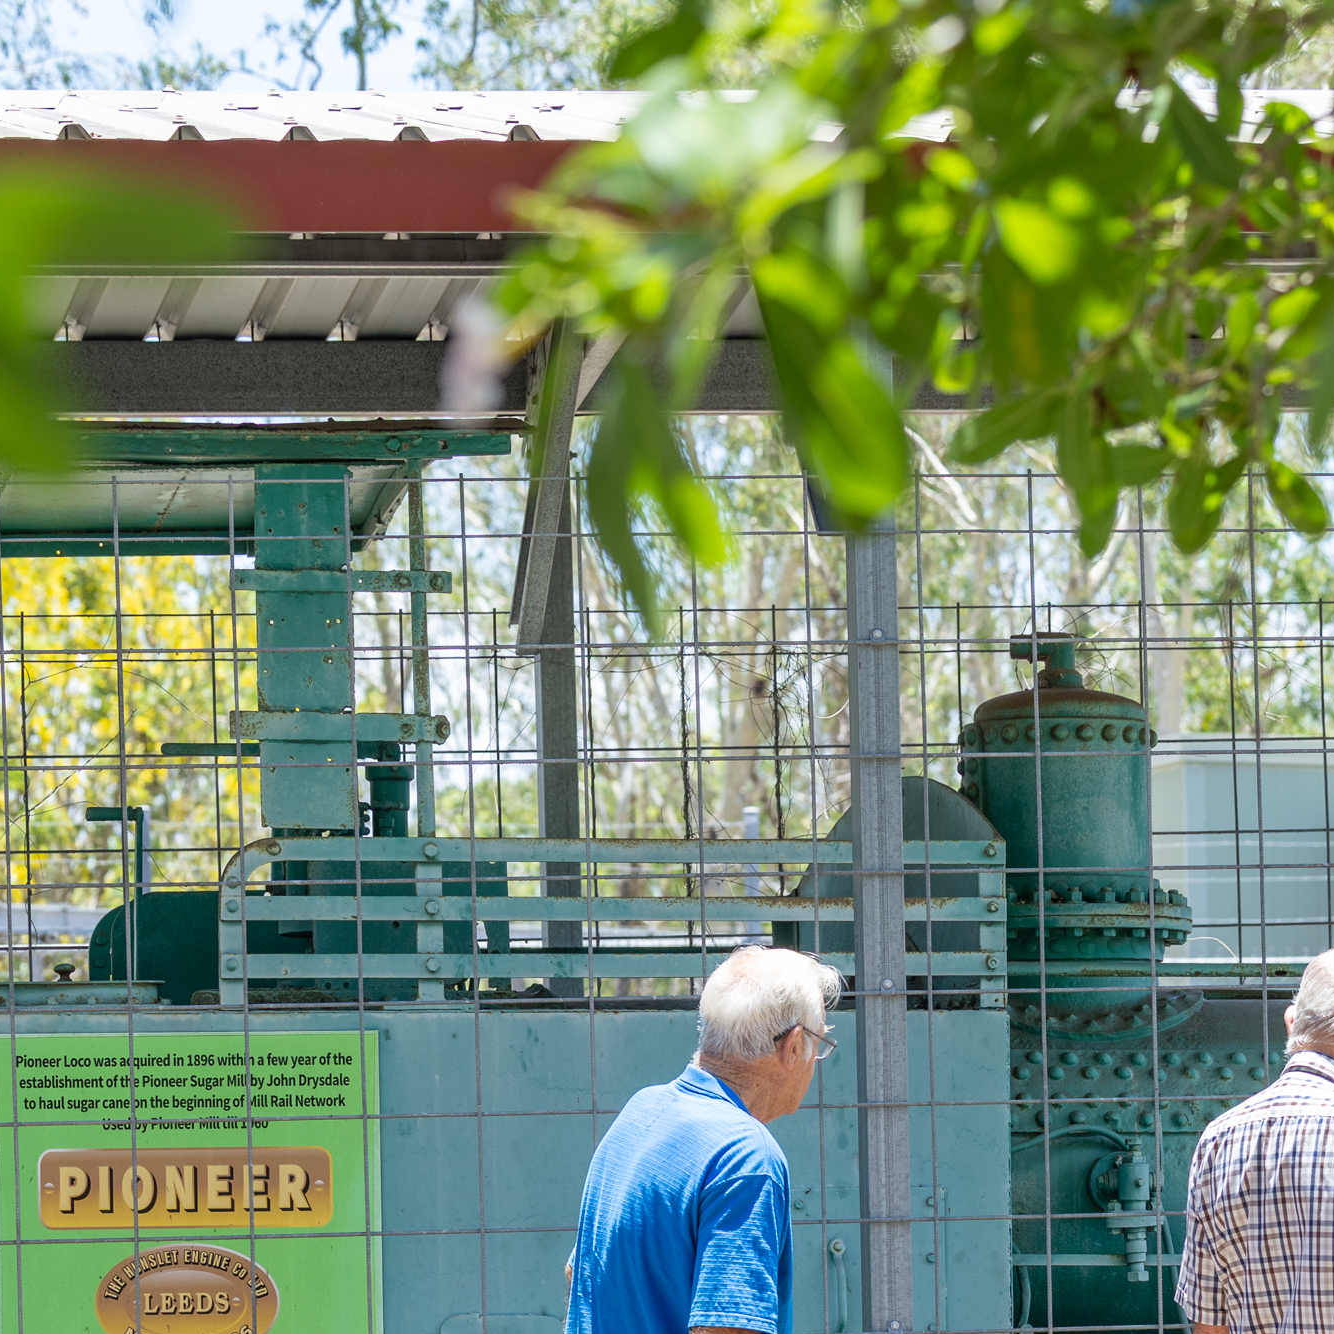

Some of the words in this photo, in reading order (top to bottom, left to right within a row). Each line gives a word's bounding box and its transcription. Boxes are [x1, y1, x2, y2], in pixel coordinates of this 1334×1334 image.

[16, 1054, 62, 1067] Pioneer
[64, 1055, 91, 1067] Loco
[93, 1057, 117, 1067] was
[119, 1054, 170, 1070] acquired
[173, 1054, 184, 1066] in
[187, 1054, 215, 1066] 1896
[217, 1053, 255, 1066] within
[257, 1056, 265, 1066] a
[266, 1053, 288, 1066] few
[291, 1055, 317, 1069] year
[319, 1053, 332, 1065] of
[333, 1053, 353, 1065] the
[19, 1075, 104, 1089] establishment
[106, 1075, 119, 1088] of
[120, 1074, 140, 1088] the
[142, 1074, 188, 1088] Pioneer
[190, 1074, 224, 1090] Sugar
[227, 1074, 247, 1087] Mill
[250, 1074, 265, 1090] by
[266, 1074, 296, 1087] John
[298, 1073, 350, 1089] Drysdale
[24, 1098, 36, 1110] to
[39, 1096, 65, 1110] haul
[67, 1099, 100, 1112] sugar
[102, 1098, 130, 1109] cane
[133, 1098, 147, 1109] on
[150, 1095, 169, 1108] the
[172, 1095, 231, 1111] beginning
[233, 1094, 245, 1108] of
[247, 1094, 268, 1107] Mill
[270, 1094, 293, 1107] Rail
[295, 1094, 346, 1107] Network
[102, 1118, 131, 1131] Used
[134, 1117, 148, 1133] by
[151, 1116, 195, 1130] Pioneer
[199, 1116, 220, 1130] Mill
[222, 1116, 238, 1130] till
[240, 1116, 269, 1129] 160
[59, 1164, 312, 1214] PIONEER
[104, 1274, 127, 1300] THE
[122, 1250, 179, 1281] HUNSLET
[184, 1250, 231, 1271] ENGINE
[232, 1262, 248, 1280] Co
[246, 1274, 269, 1298] LTD
[143, 1291, 231, 1315] LEEDS
